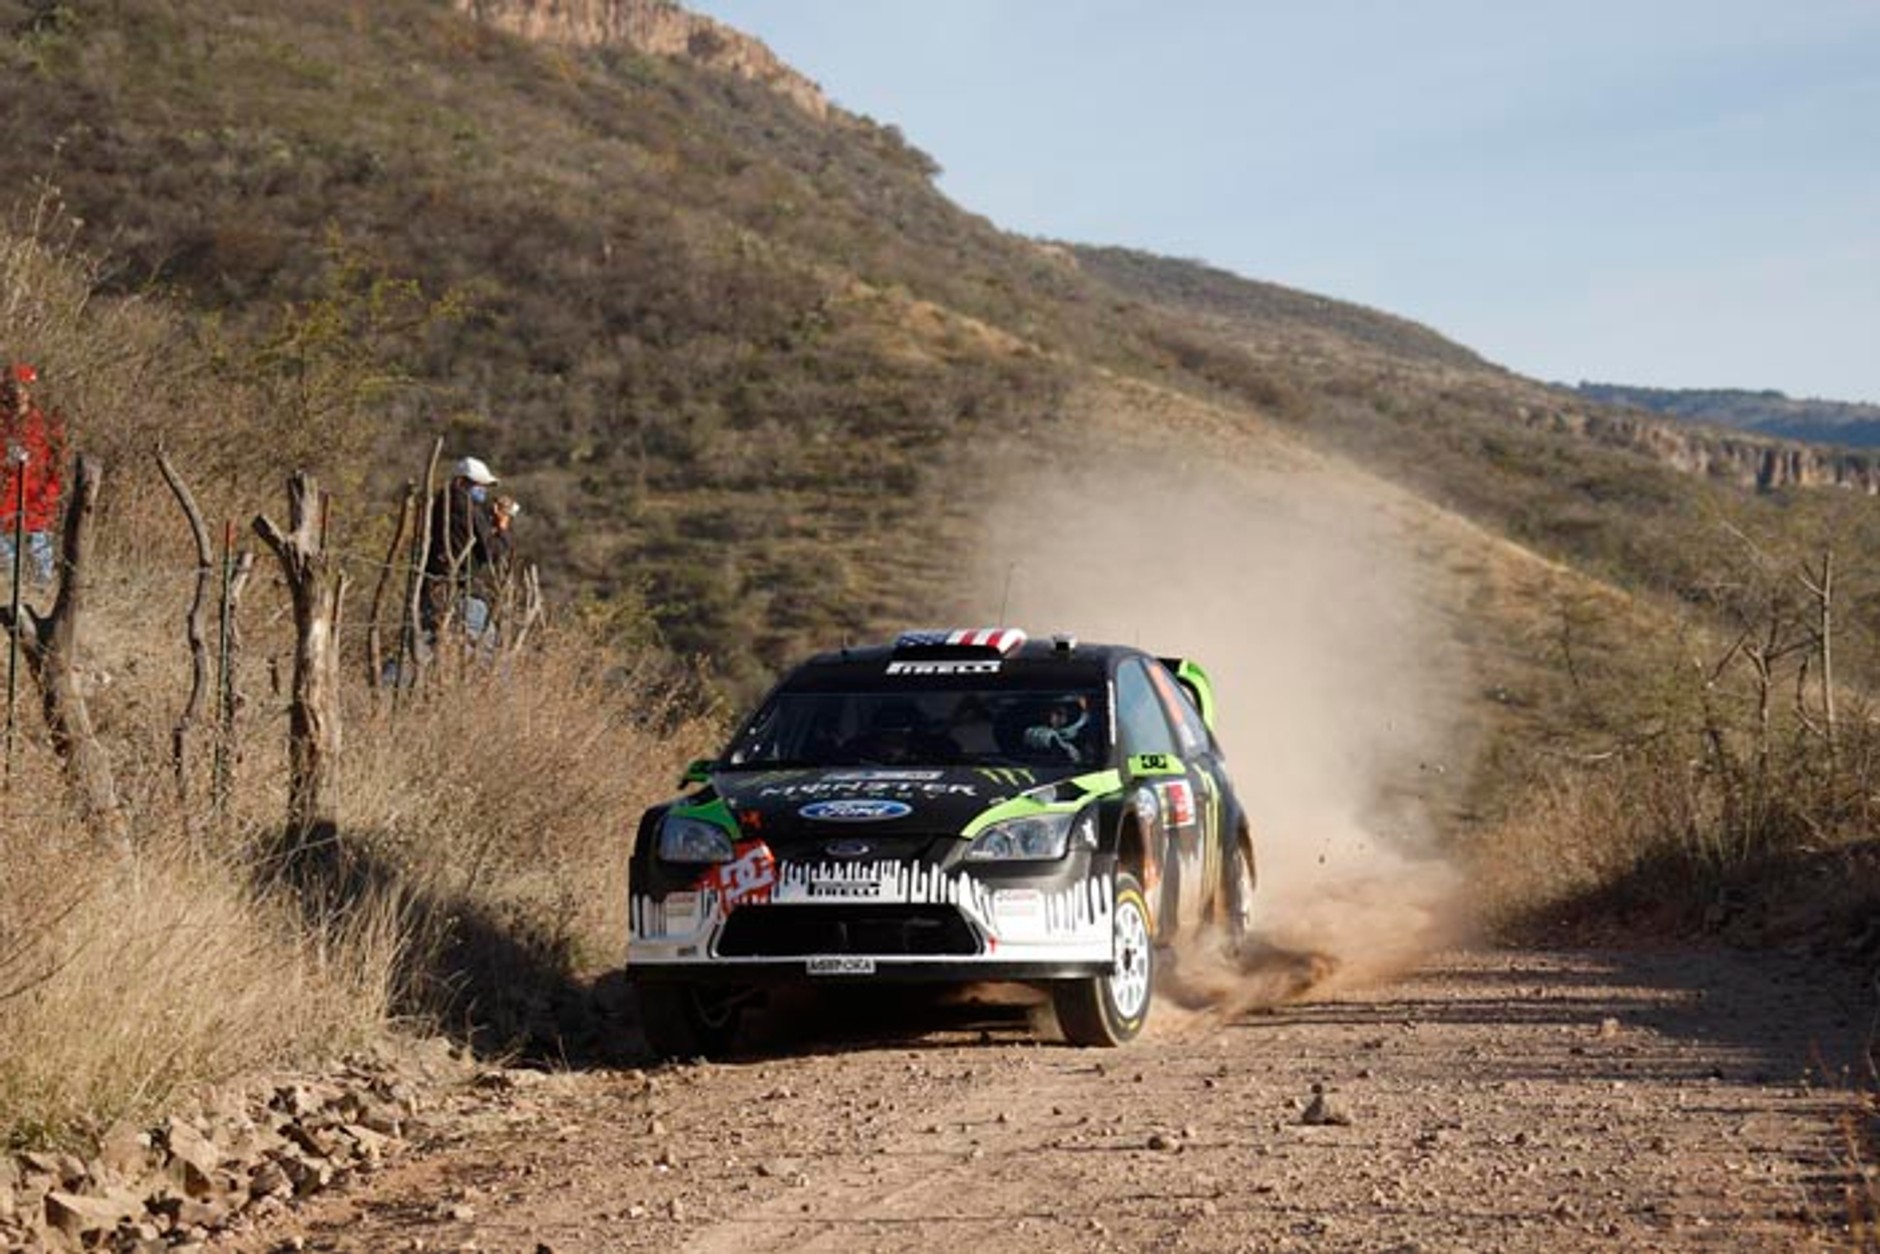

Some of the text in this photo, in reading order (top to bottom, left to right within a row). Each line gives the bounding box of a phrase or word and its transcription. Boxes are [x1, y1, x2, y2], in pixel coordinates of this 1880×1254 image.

[886, 661, 1002, 675] PIRELLI
[760, 780, 978, 797] MONSTER
[811, 802, 895, 818] Ford
[808, 881, 880, 896] PIRELLI
